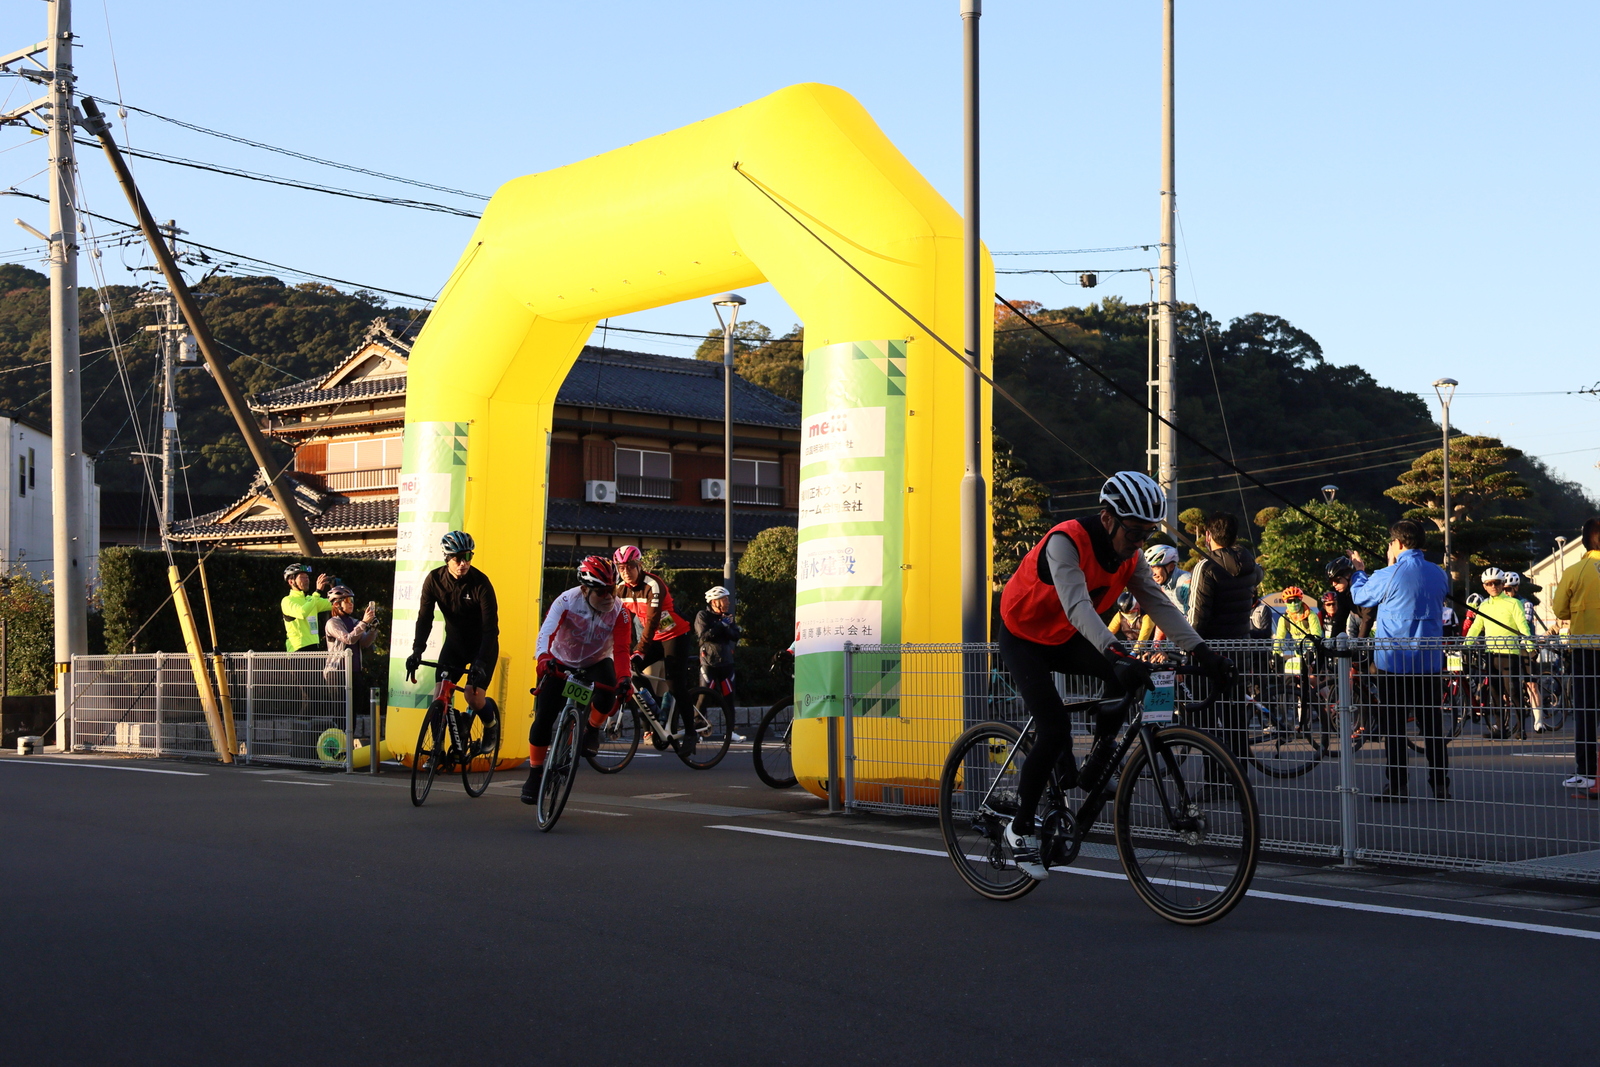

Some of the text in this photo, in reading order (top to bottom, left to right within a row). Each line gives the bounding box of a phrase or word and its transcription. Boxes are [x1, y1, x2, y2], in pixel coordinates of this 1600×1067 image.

[800, 554, 857, 581] 清水建設
[566, 684, 590, 702] 005
[1150, 690, 1171, 699] サポート
[447, 703, 463, 752] MERIDA
